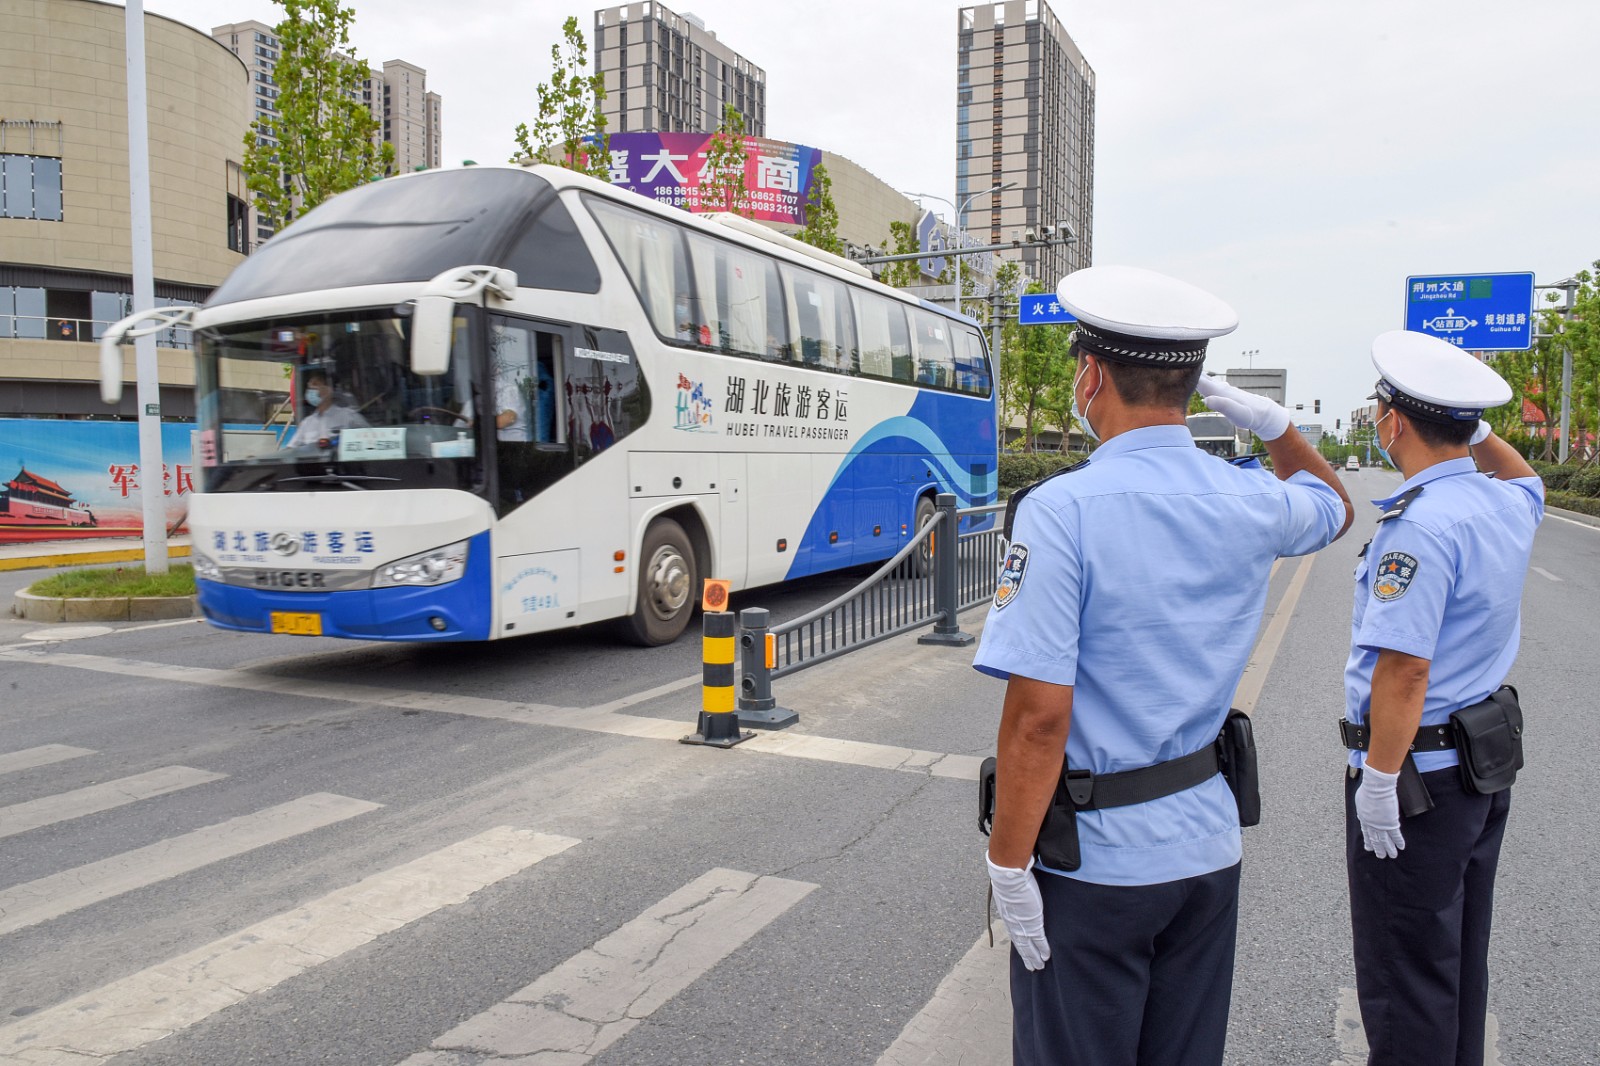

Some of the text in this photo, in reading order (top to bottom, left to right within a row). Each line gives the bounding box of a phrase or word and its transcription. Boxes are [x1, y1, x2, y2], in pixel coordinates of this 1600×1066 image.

[654, 186, 672, 195] 186
[674, 186, 698, 196] 9615
[751, 190, 774, 202] 0862
[776, 193, 798, 205] 5707
[674, 196, 698, 206] 8618
[751, 200, 775, 212] 9083
[776, 203, 798, 215] 2121
[1413, 281, 1464, 292] 荆州大道
[1420, 293, 1447, 301] Jingzhou
[1032, 301, 1070, 315] 火车
[1435, 319, 1464, 328] 站西路
[1485, 313, 1526, 325] 规划道路
[725, 375, 848, 422] 湖北旅游客运
[726, 422, 849, 441] HUBEI TRAVEL PASSENGER
[108, 463, 194, 497] 军民
[254, 571, 326, 588] HIGER
